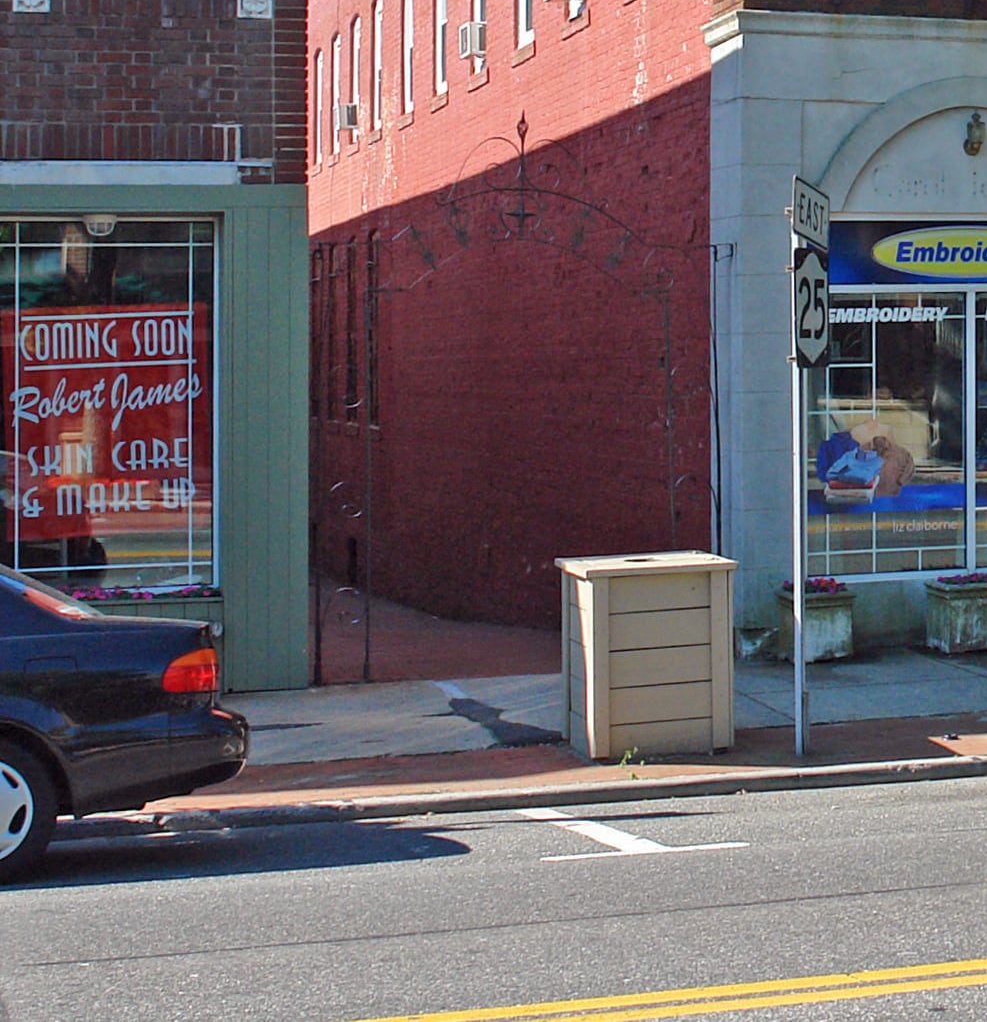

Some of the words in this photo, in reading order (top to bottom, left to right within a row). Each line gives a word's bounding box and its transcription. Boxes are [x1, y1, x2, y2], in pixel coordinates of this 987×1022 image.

[799, 193, 825, 235] EAST
[798, 276, 826, 340] 25
[828, 306, 949, 324] EMBROIDERY
[19, 320, 118, 362] COMING
[131, 318, 192, 357] SOON
[10, 377, 105, 427] Robert
[111, 373, 203, 431] James
[28, 443, 94, 478] SKIN
[112, 438, 190, 472] CARE
[22, 486, 44, 518] &
[57, 480, 150, 515] MAKE
[906, 519, 958, 532] claiborne
